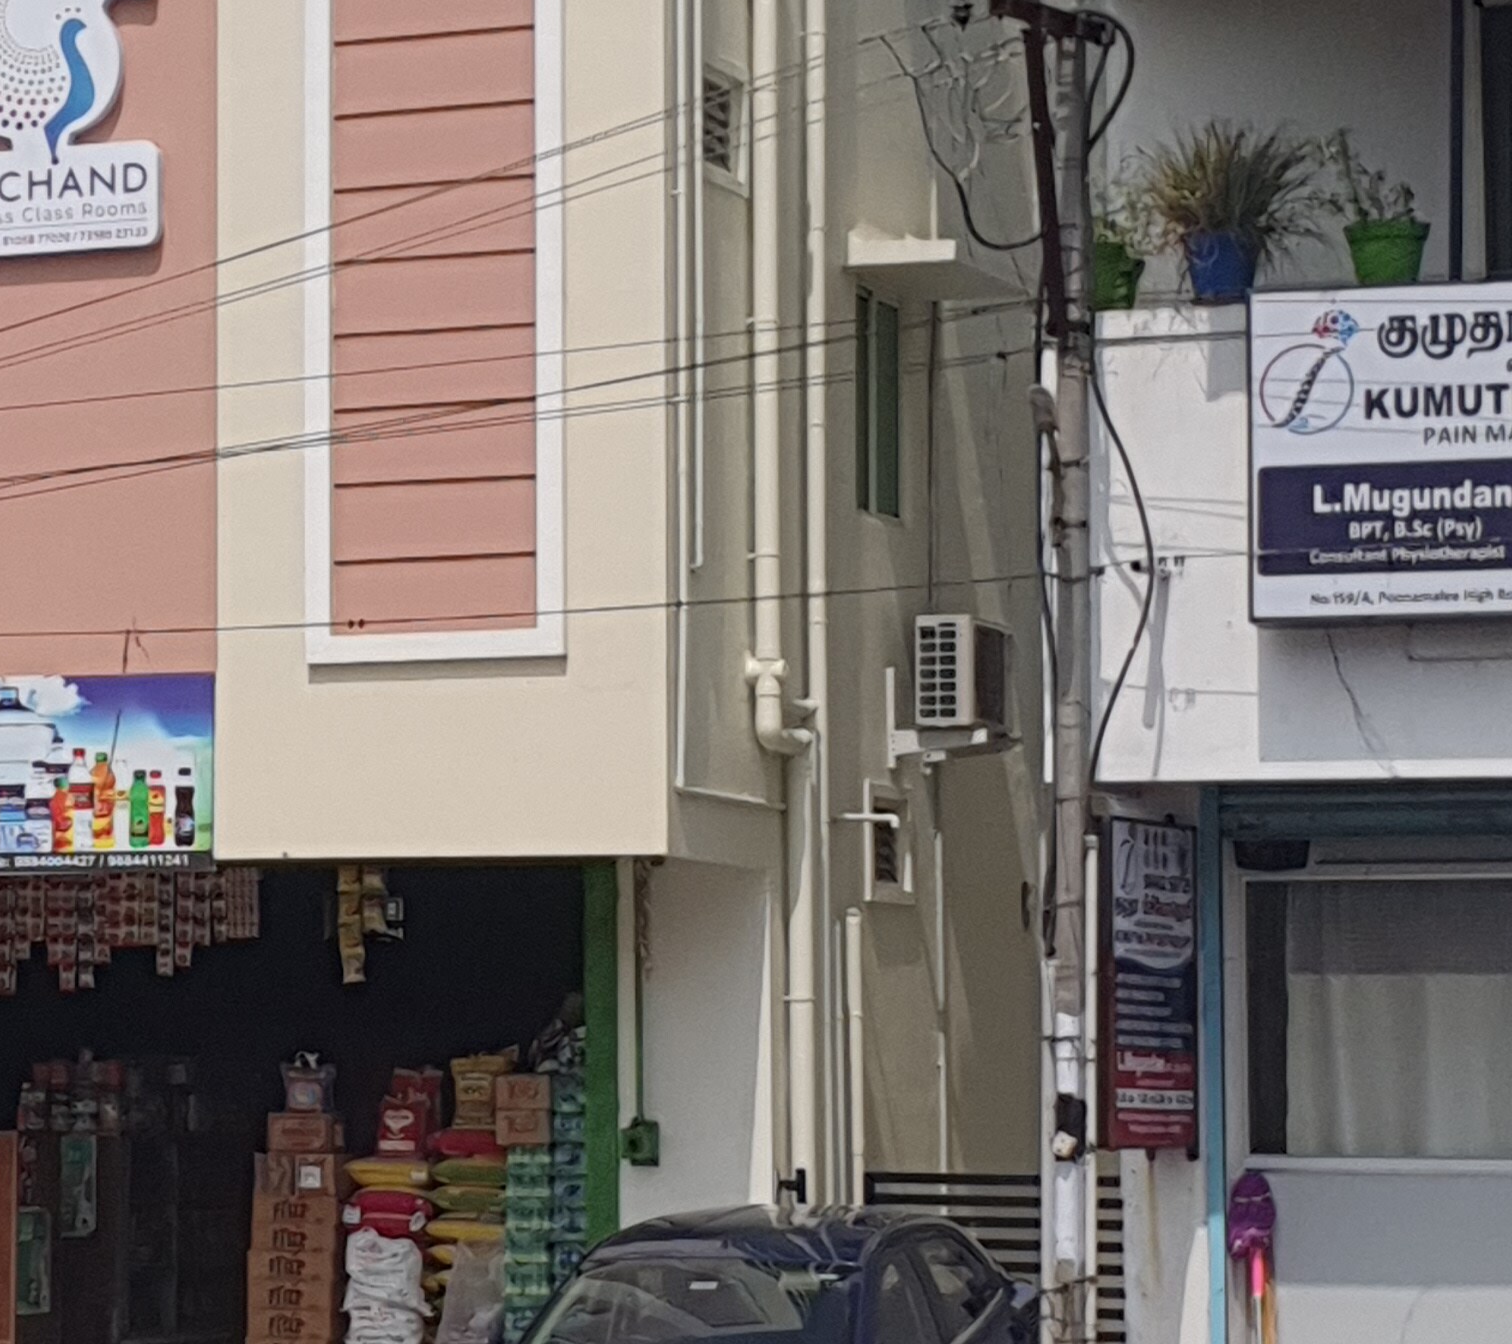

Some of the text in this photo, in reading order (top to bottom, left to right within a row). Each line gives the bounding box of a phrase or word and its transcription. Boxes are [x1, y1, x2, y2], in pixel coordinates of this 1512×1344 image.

[22, 206, 74, 223] Class
[82, 201, 148, 219] Rooms
[1364, 383, 1510, 420] KUMUT
[1424, 425, 1477, 445] PAIN
[1349, 516, 1483, 542] BPT, B.Sc (Psy)
